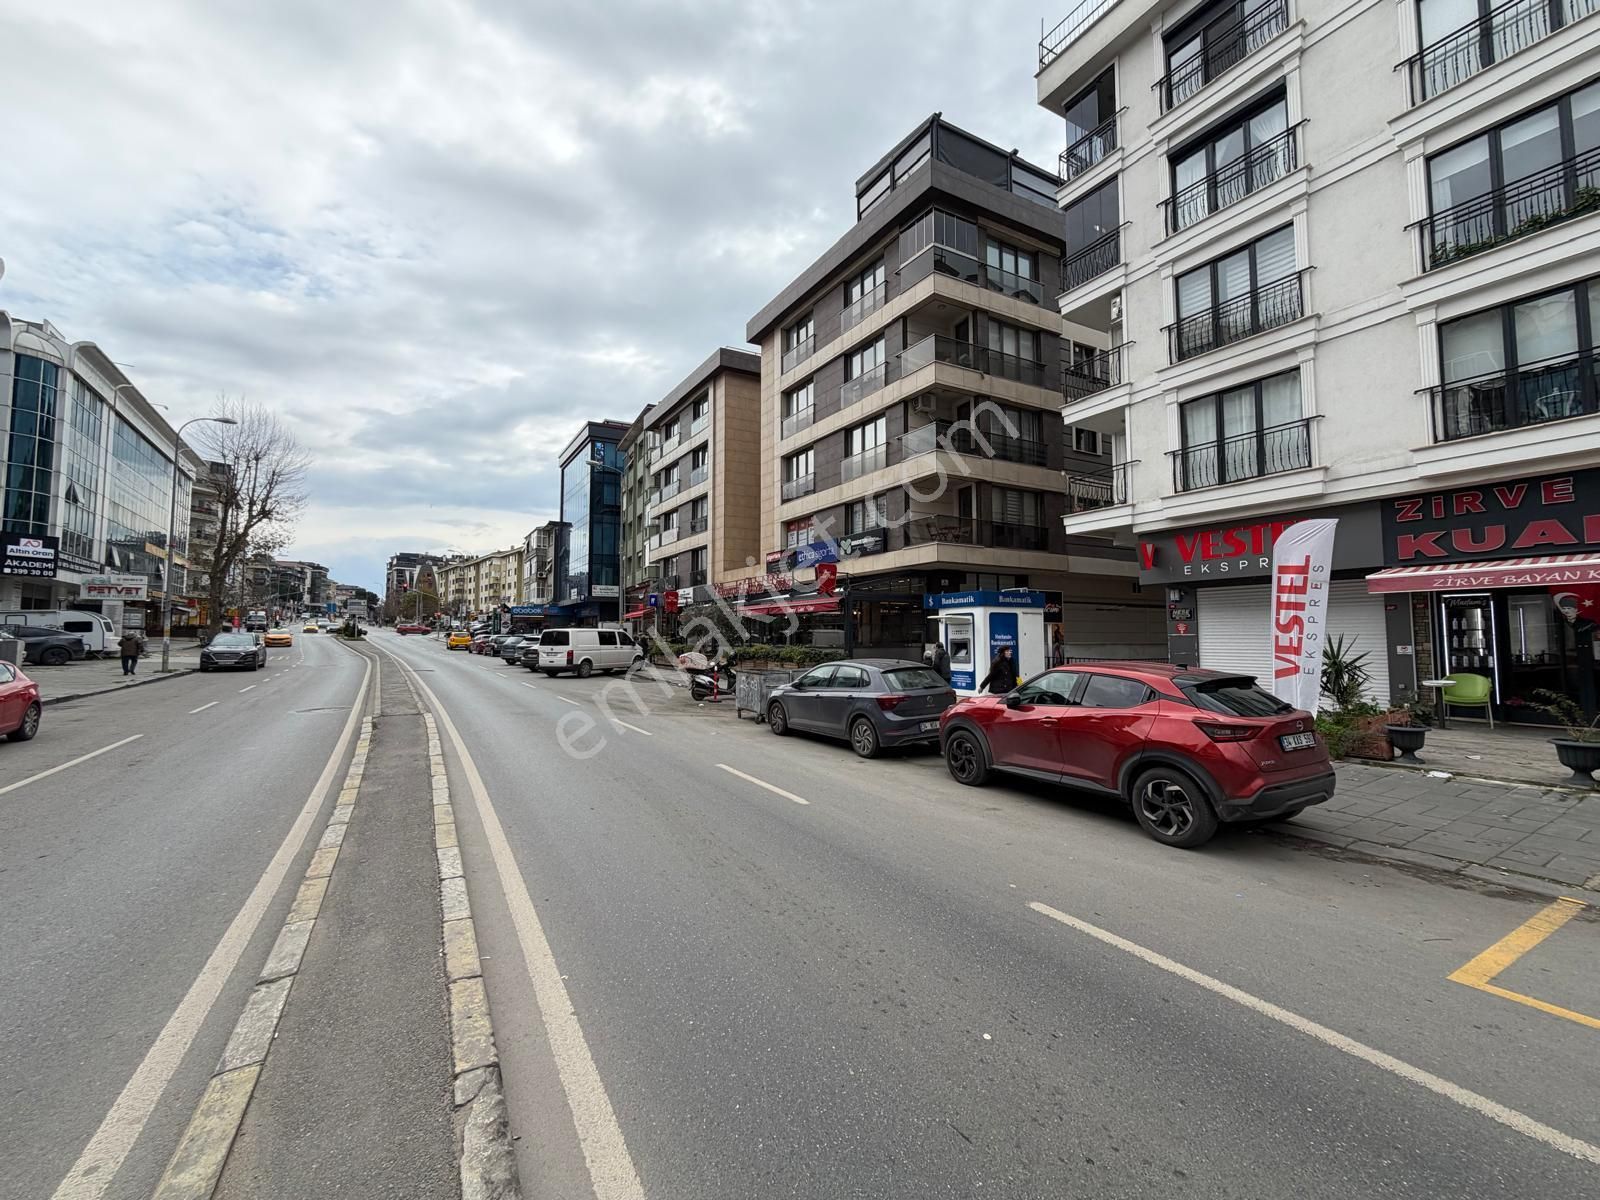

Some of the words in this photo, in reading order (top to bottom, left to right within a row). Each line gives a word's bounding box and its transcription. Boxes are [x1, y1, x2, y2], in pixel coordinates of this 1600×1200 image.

[1394, 476, 1576, 523] ZİRVE
[1174, 518, 1308, 565] VEST
[4, 558, 55, 569] AKADEMİ
[1183, 557, 1270, 575] EKSPR
[1433, 574, 1495, 587] ZİRVE
[1502, 570, 1581, 585] BAYAN
[87, 585, 142, 595] PETVET
[941, 595, 975, 605] Bankamatik
[999, 595, 1032, 604] Bankamatik
[1274, 554, 1311, 680] VESTEL
[1303, 564, 1325, 676] EKSPRES
